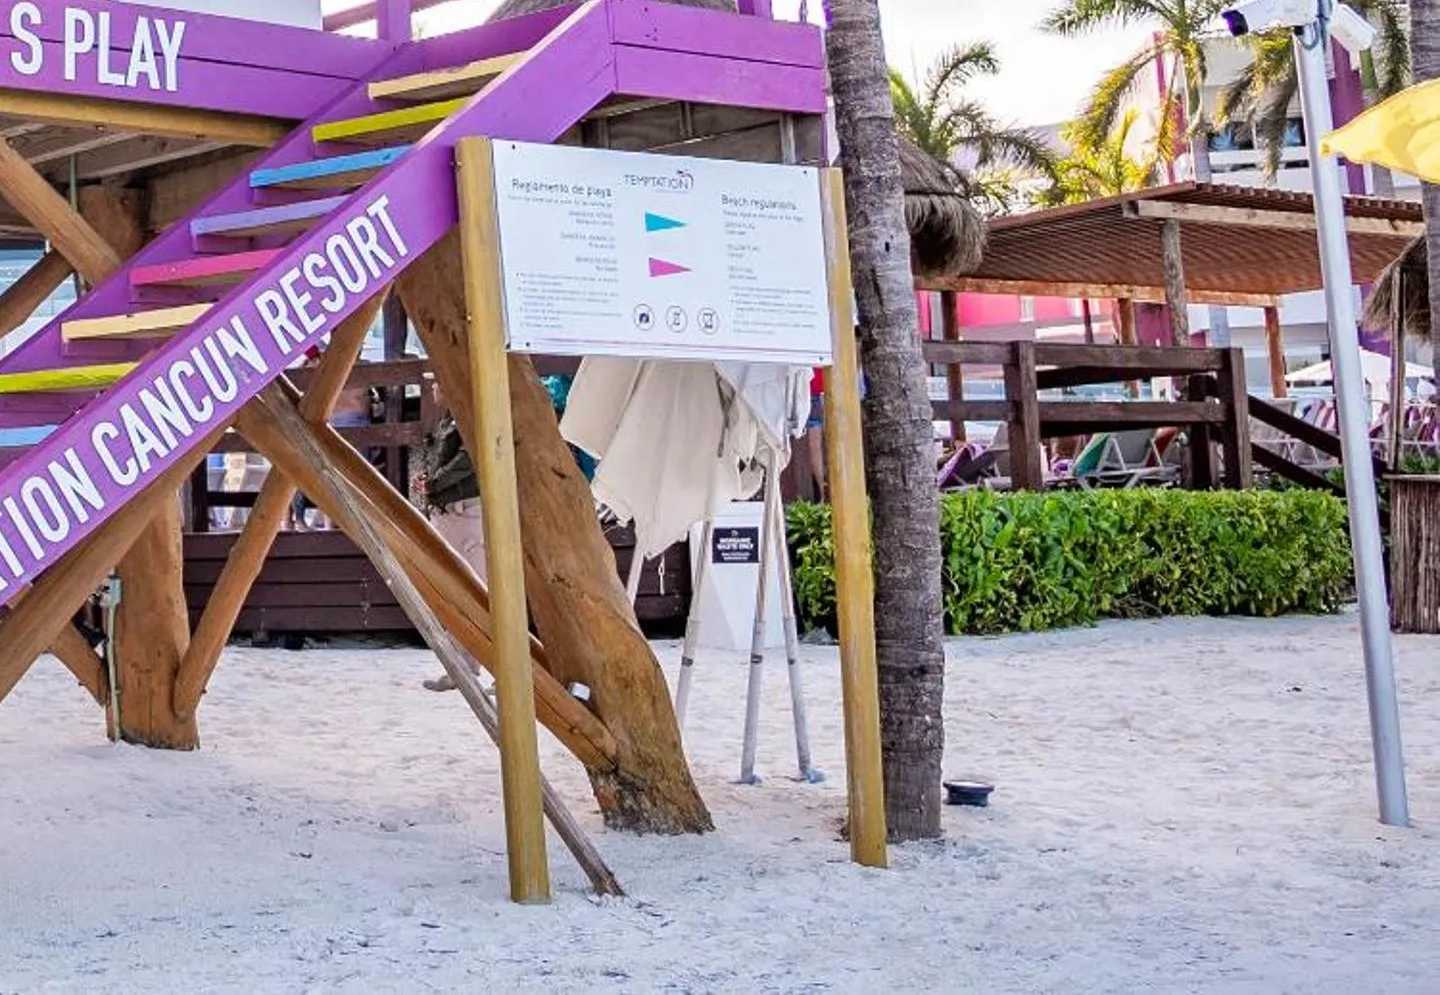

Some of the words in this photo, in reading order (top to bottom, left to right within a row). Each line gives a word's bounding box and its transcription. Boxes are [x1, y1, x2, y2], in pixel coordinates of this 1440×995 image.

[10, 1, 44, 75] S
[64, 7, 186, 92] PLAY
[624, 174, 690, 189] TEMPTATION
[90, 315, 261, 486] CANCUN
[259, 195, 408, 354] RESORT
